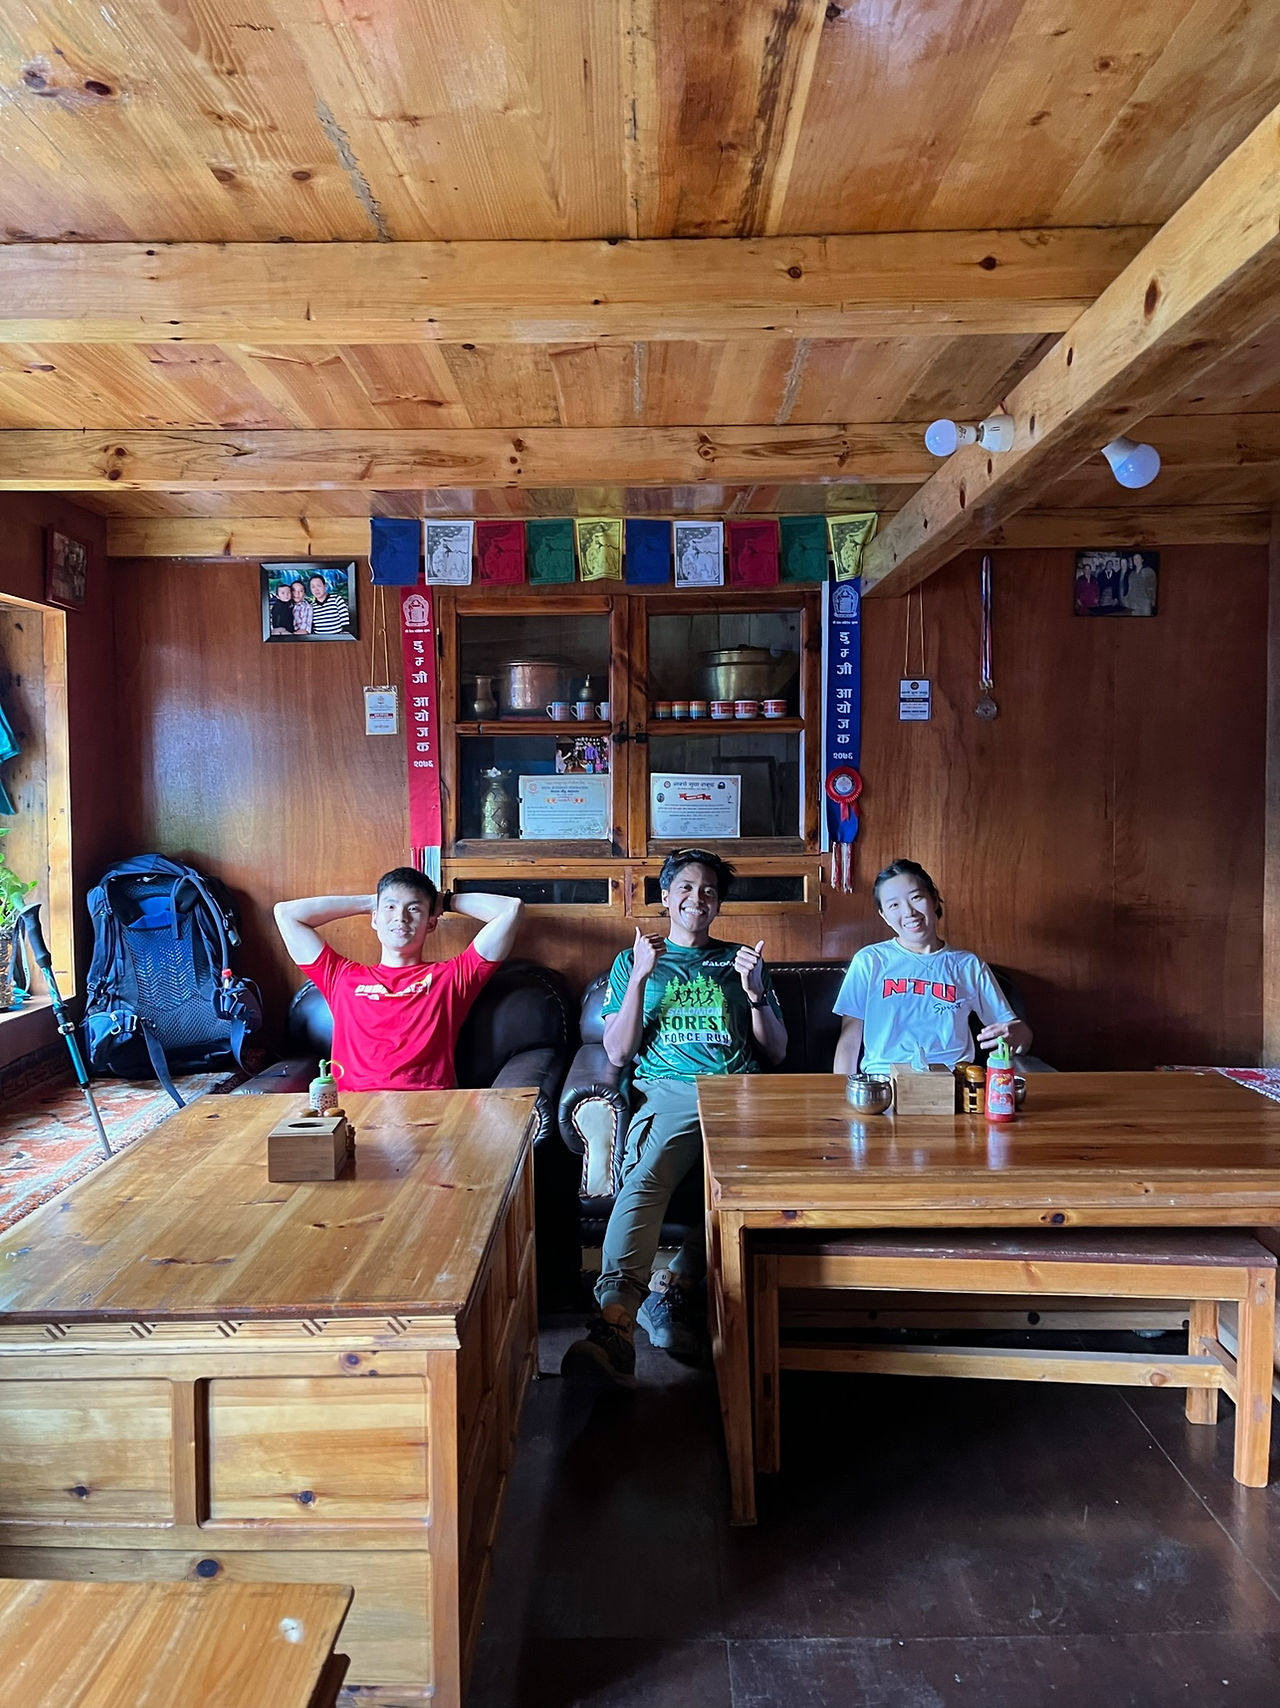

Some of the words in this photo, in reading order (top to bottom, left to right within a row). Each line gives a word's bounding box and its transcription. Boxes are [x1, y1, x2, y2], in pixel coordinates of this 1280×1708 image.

[883, 978, 957, 1003] NTU
[667, 1007, 723, 1016] SALOMON
[661, 1015, 727, 1032] FOREST
[664, 1032, 701, 1043] FORCE
[706, 1033, 729, 1044] RUN
